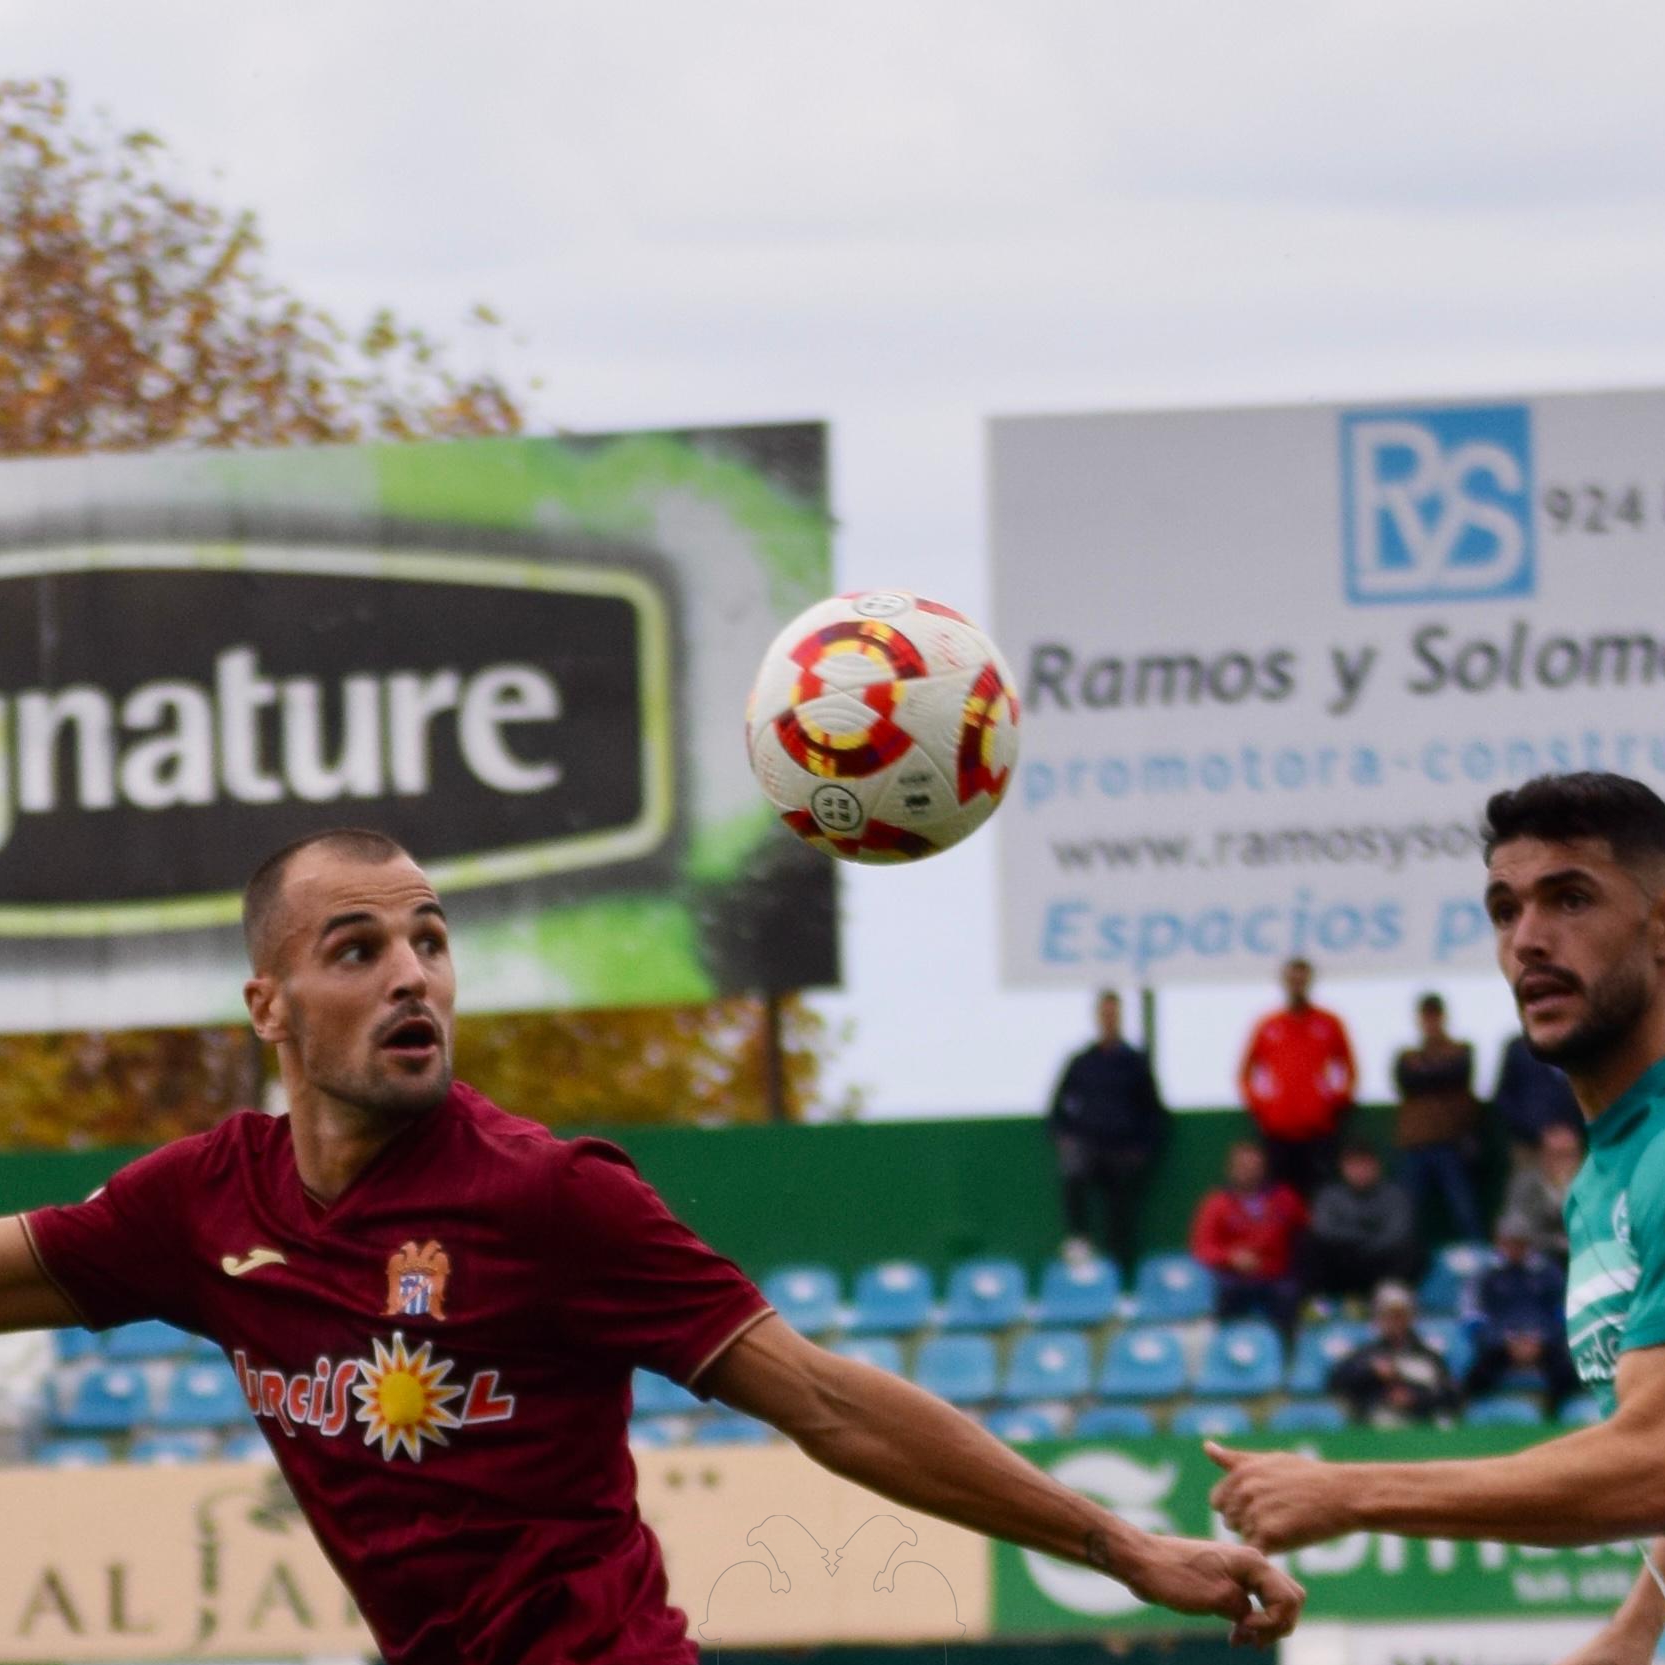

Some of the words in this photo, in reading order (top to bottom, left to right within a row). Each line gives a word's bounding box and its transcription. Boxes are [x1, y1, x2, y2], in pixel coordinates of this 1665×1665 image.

[1543, 484, 1647, 537] 924
[1026, 641, 1295, 715] Ramos
[1327, 640, 1378, 716] y
[1037, 886, 1405, 972] Espacios
[15, 1500, 363, 1650] ALJA
